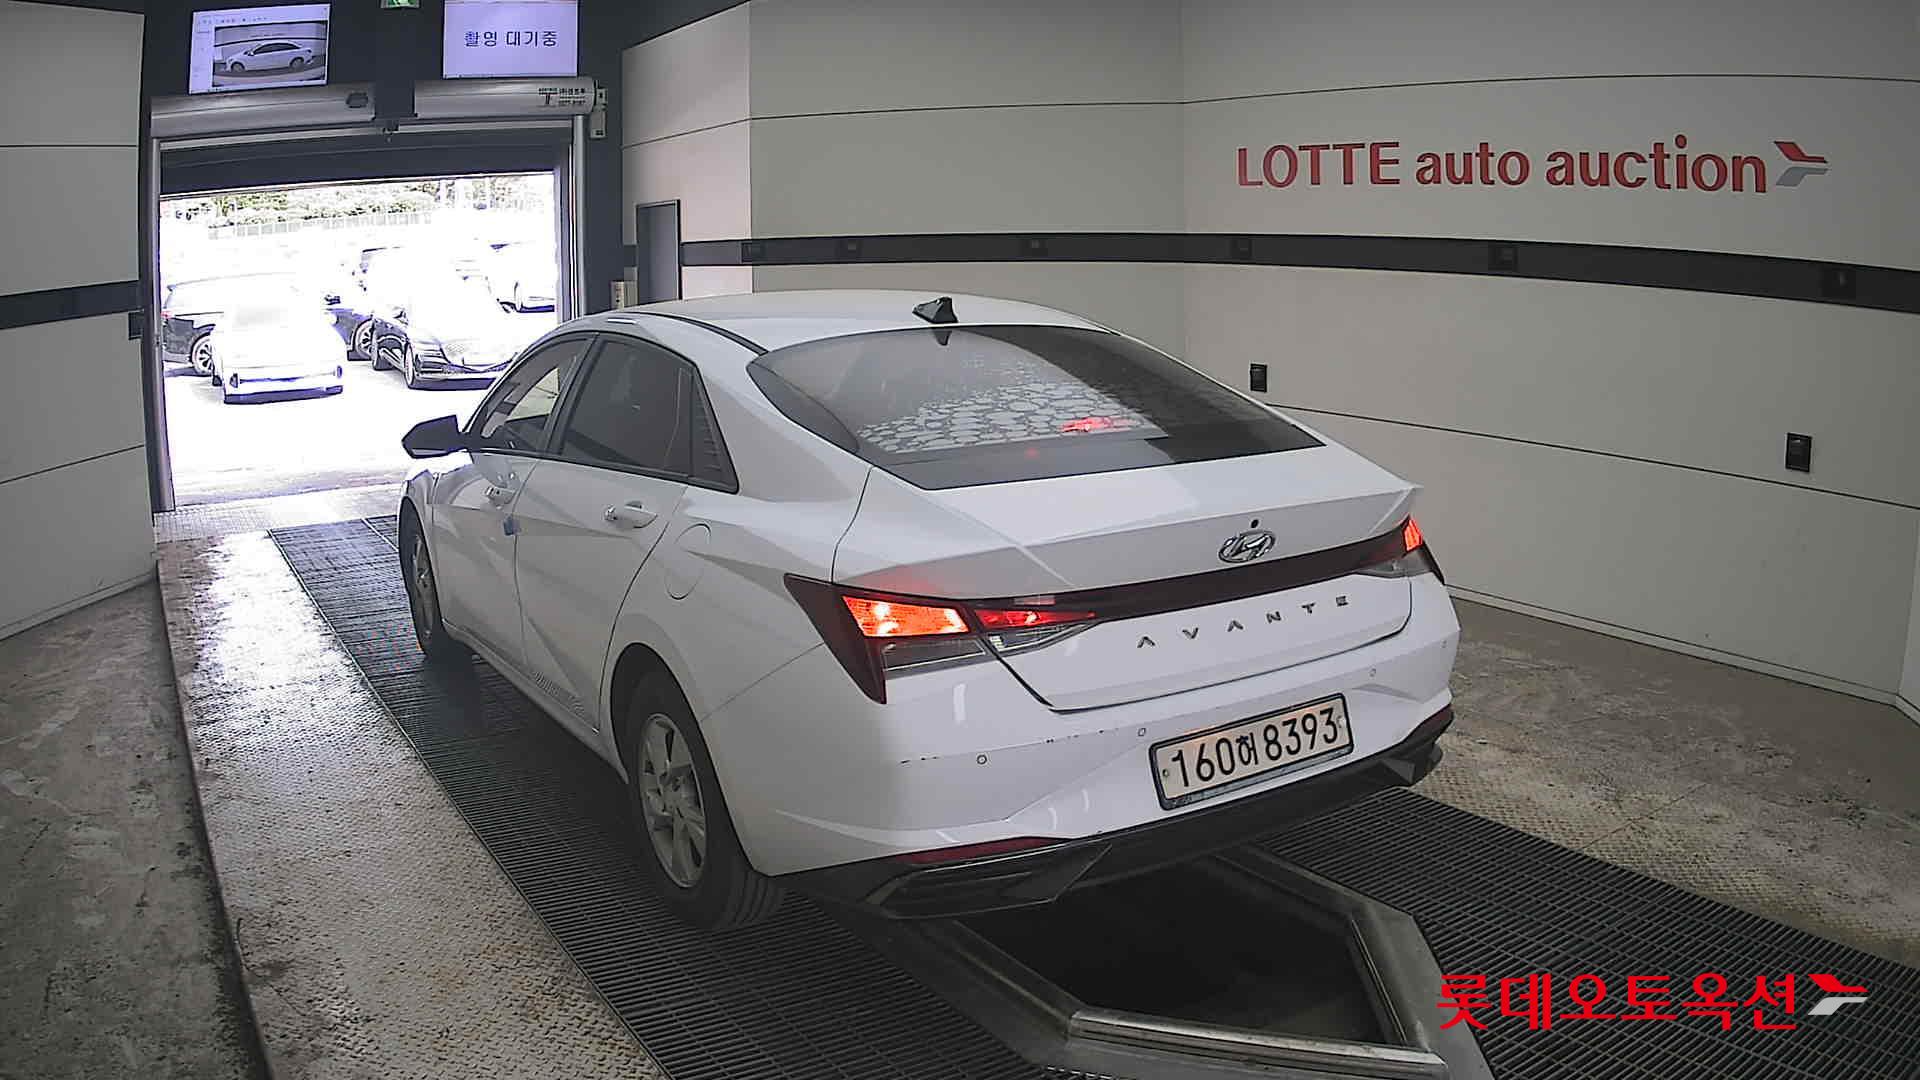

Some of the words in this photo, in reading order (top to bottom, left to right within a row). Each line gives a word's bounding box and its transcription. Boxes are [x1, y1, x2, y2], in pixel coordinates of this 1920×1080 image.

[506, 31, 557, 47] 대기중
[1236, 141, 1400, 188] LOTTE
[1416, 141, 1530, 186] auto
[1545, 134, 1767, 193] auction
[1137, 595, 1349, 649] AVANTE
